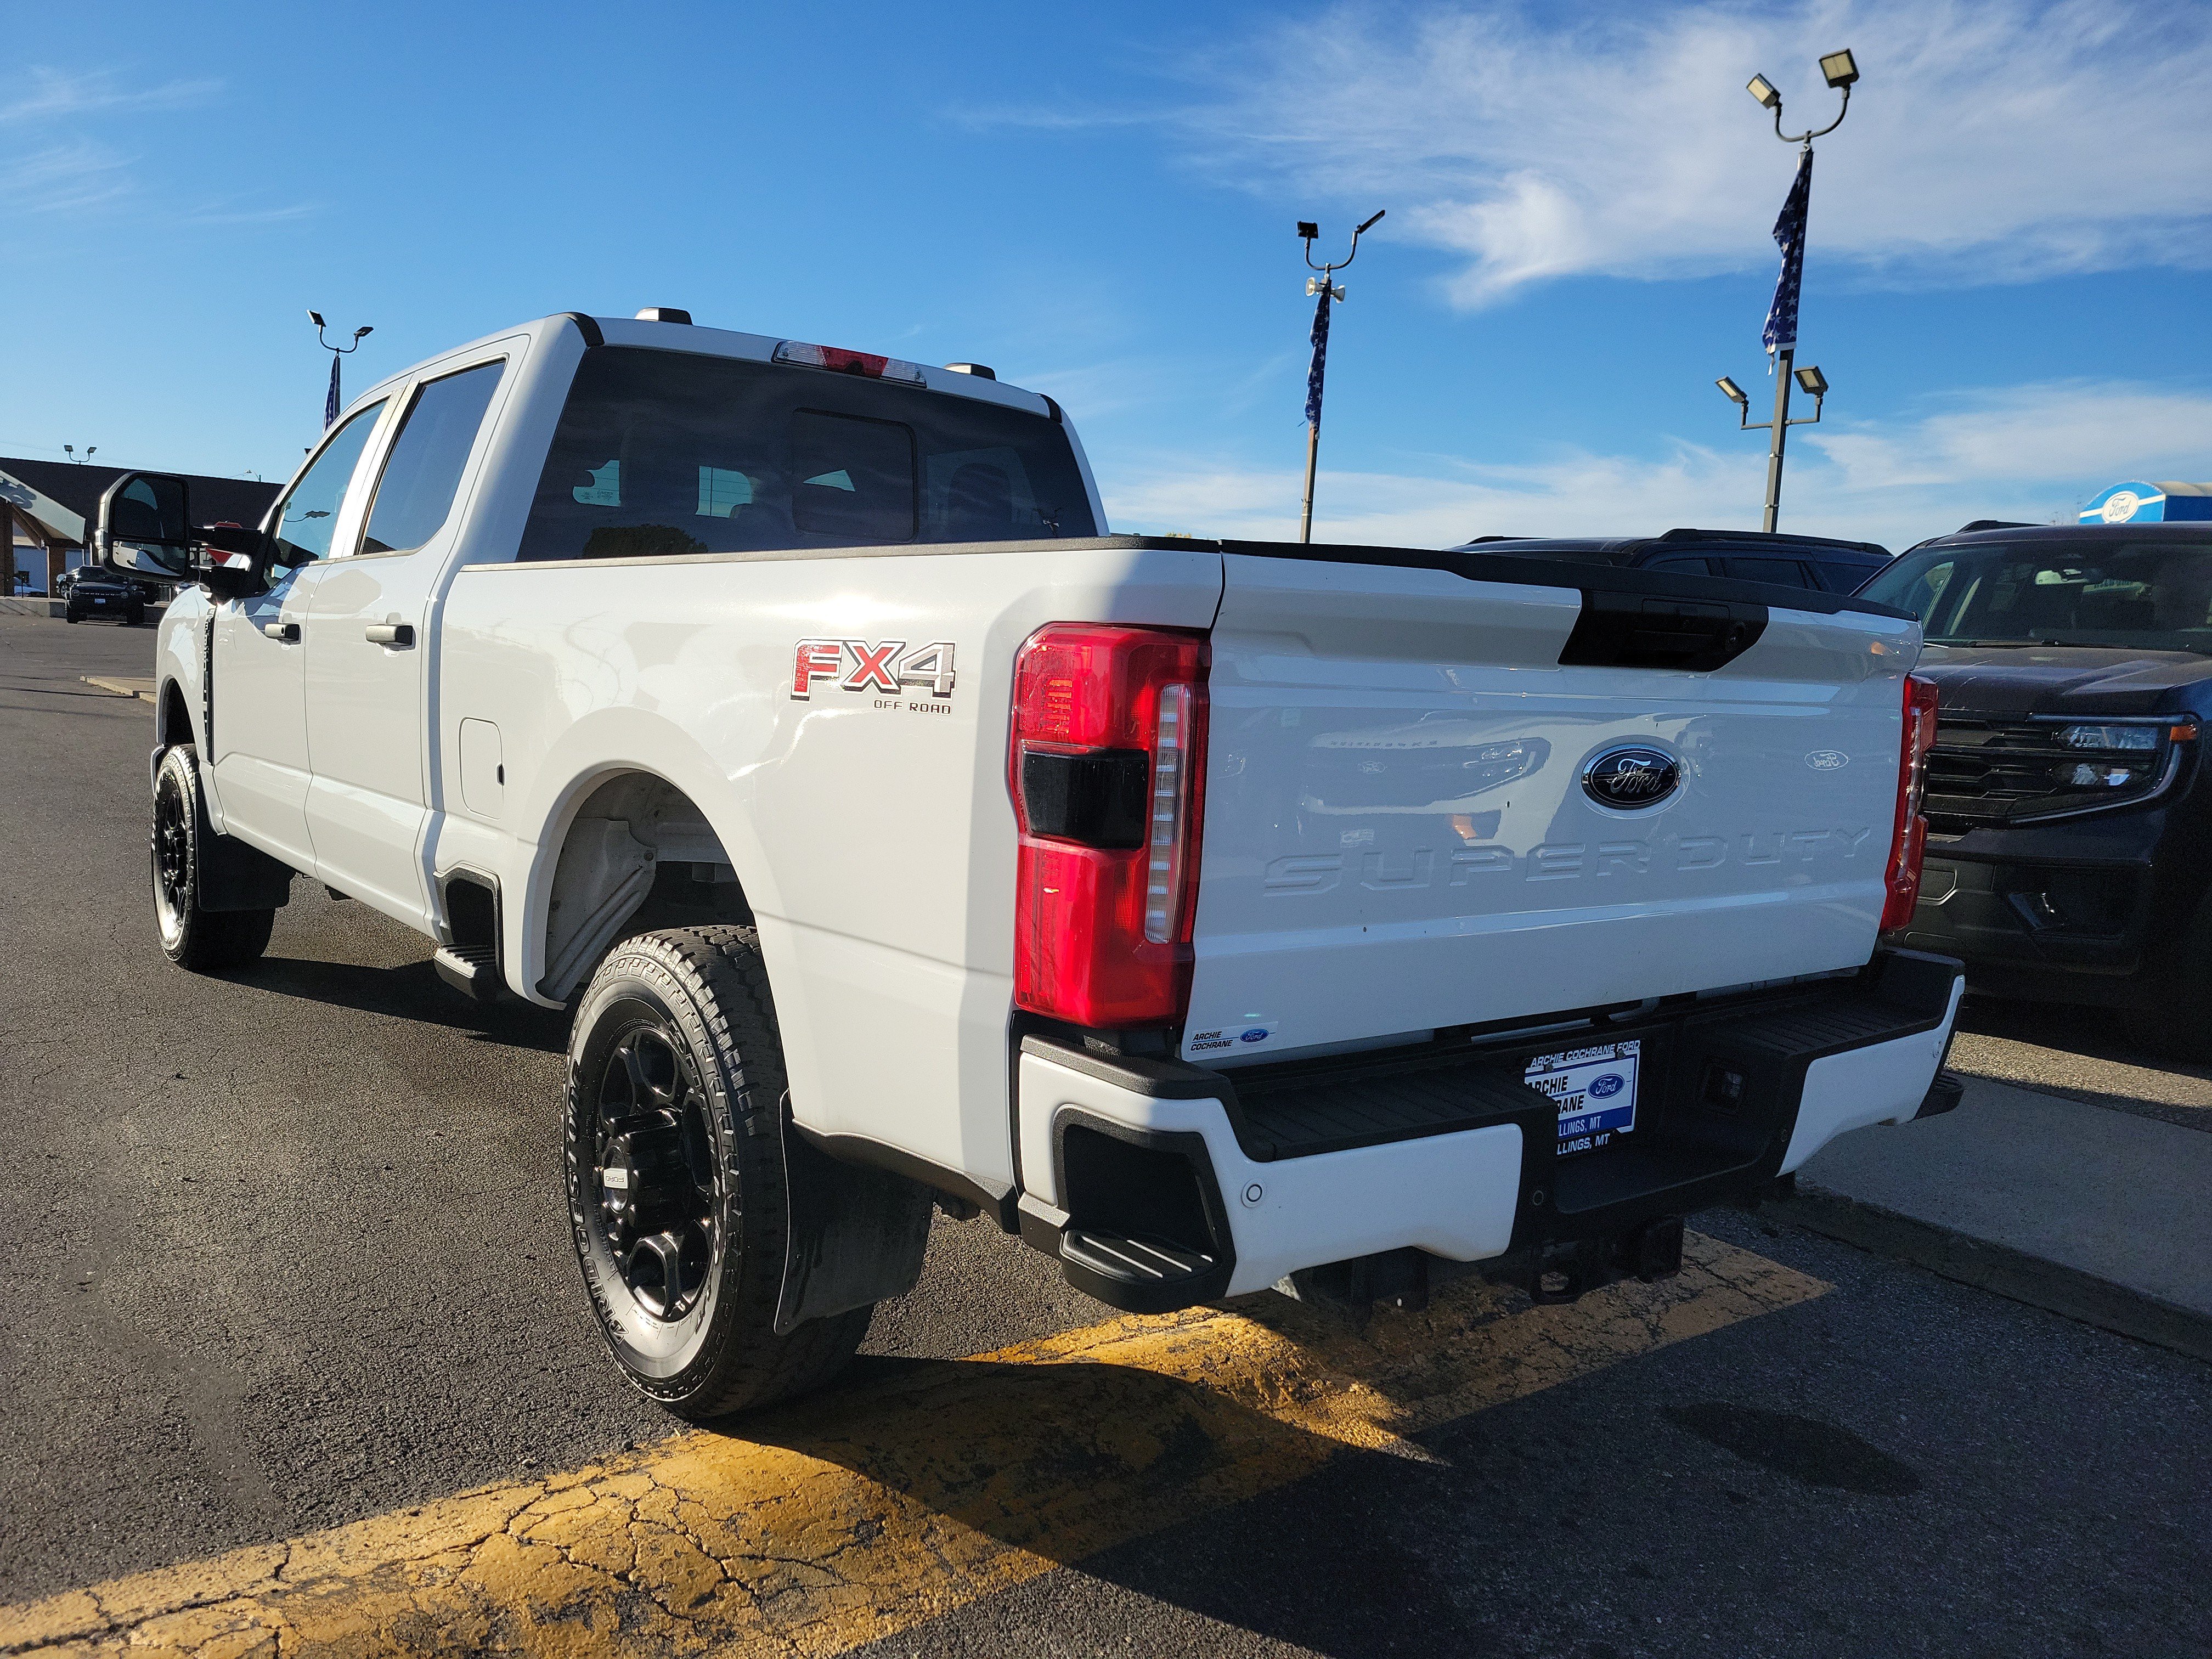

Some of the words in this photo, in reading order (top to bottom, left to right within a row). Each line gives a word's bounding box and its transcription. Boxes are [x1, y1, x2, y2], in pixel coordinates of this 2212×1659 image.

[2109, 496, 2131, 517] Ford
[790, 638, 956, 702] FX4
[874, 699, 902, 710] OFF
[909, 701, 951, 714] ROAD
[1607, 758, 1664, 793] Ford
[1263, 840, 1651, 897] SUPER
[1677, 827, 1870, 872] DUTY
[1192, 1031, 1222, 1041] ARCHIE
[1245, 1031, 1263, 1040] Ford
[1190, 1039, 1233, 1051] COCHRANE
[1530, 1052, 1565, 1068] ARCHIE
[1566, 1043, 1615, 1060] COCHRANE
[1616, 1040, 1641, 1052] FORD
[1595, 1077, 1617, 1094] Ford
[1589, 1115, 1601, 1130] MT
[1595, 1133, 1611, 1147] MT
